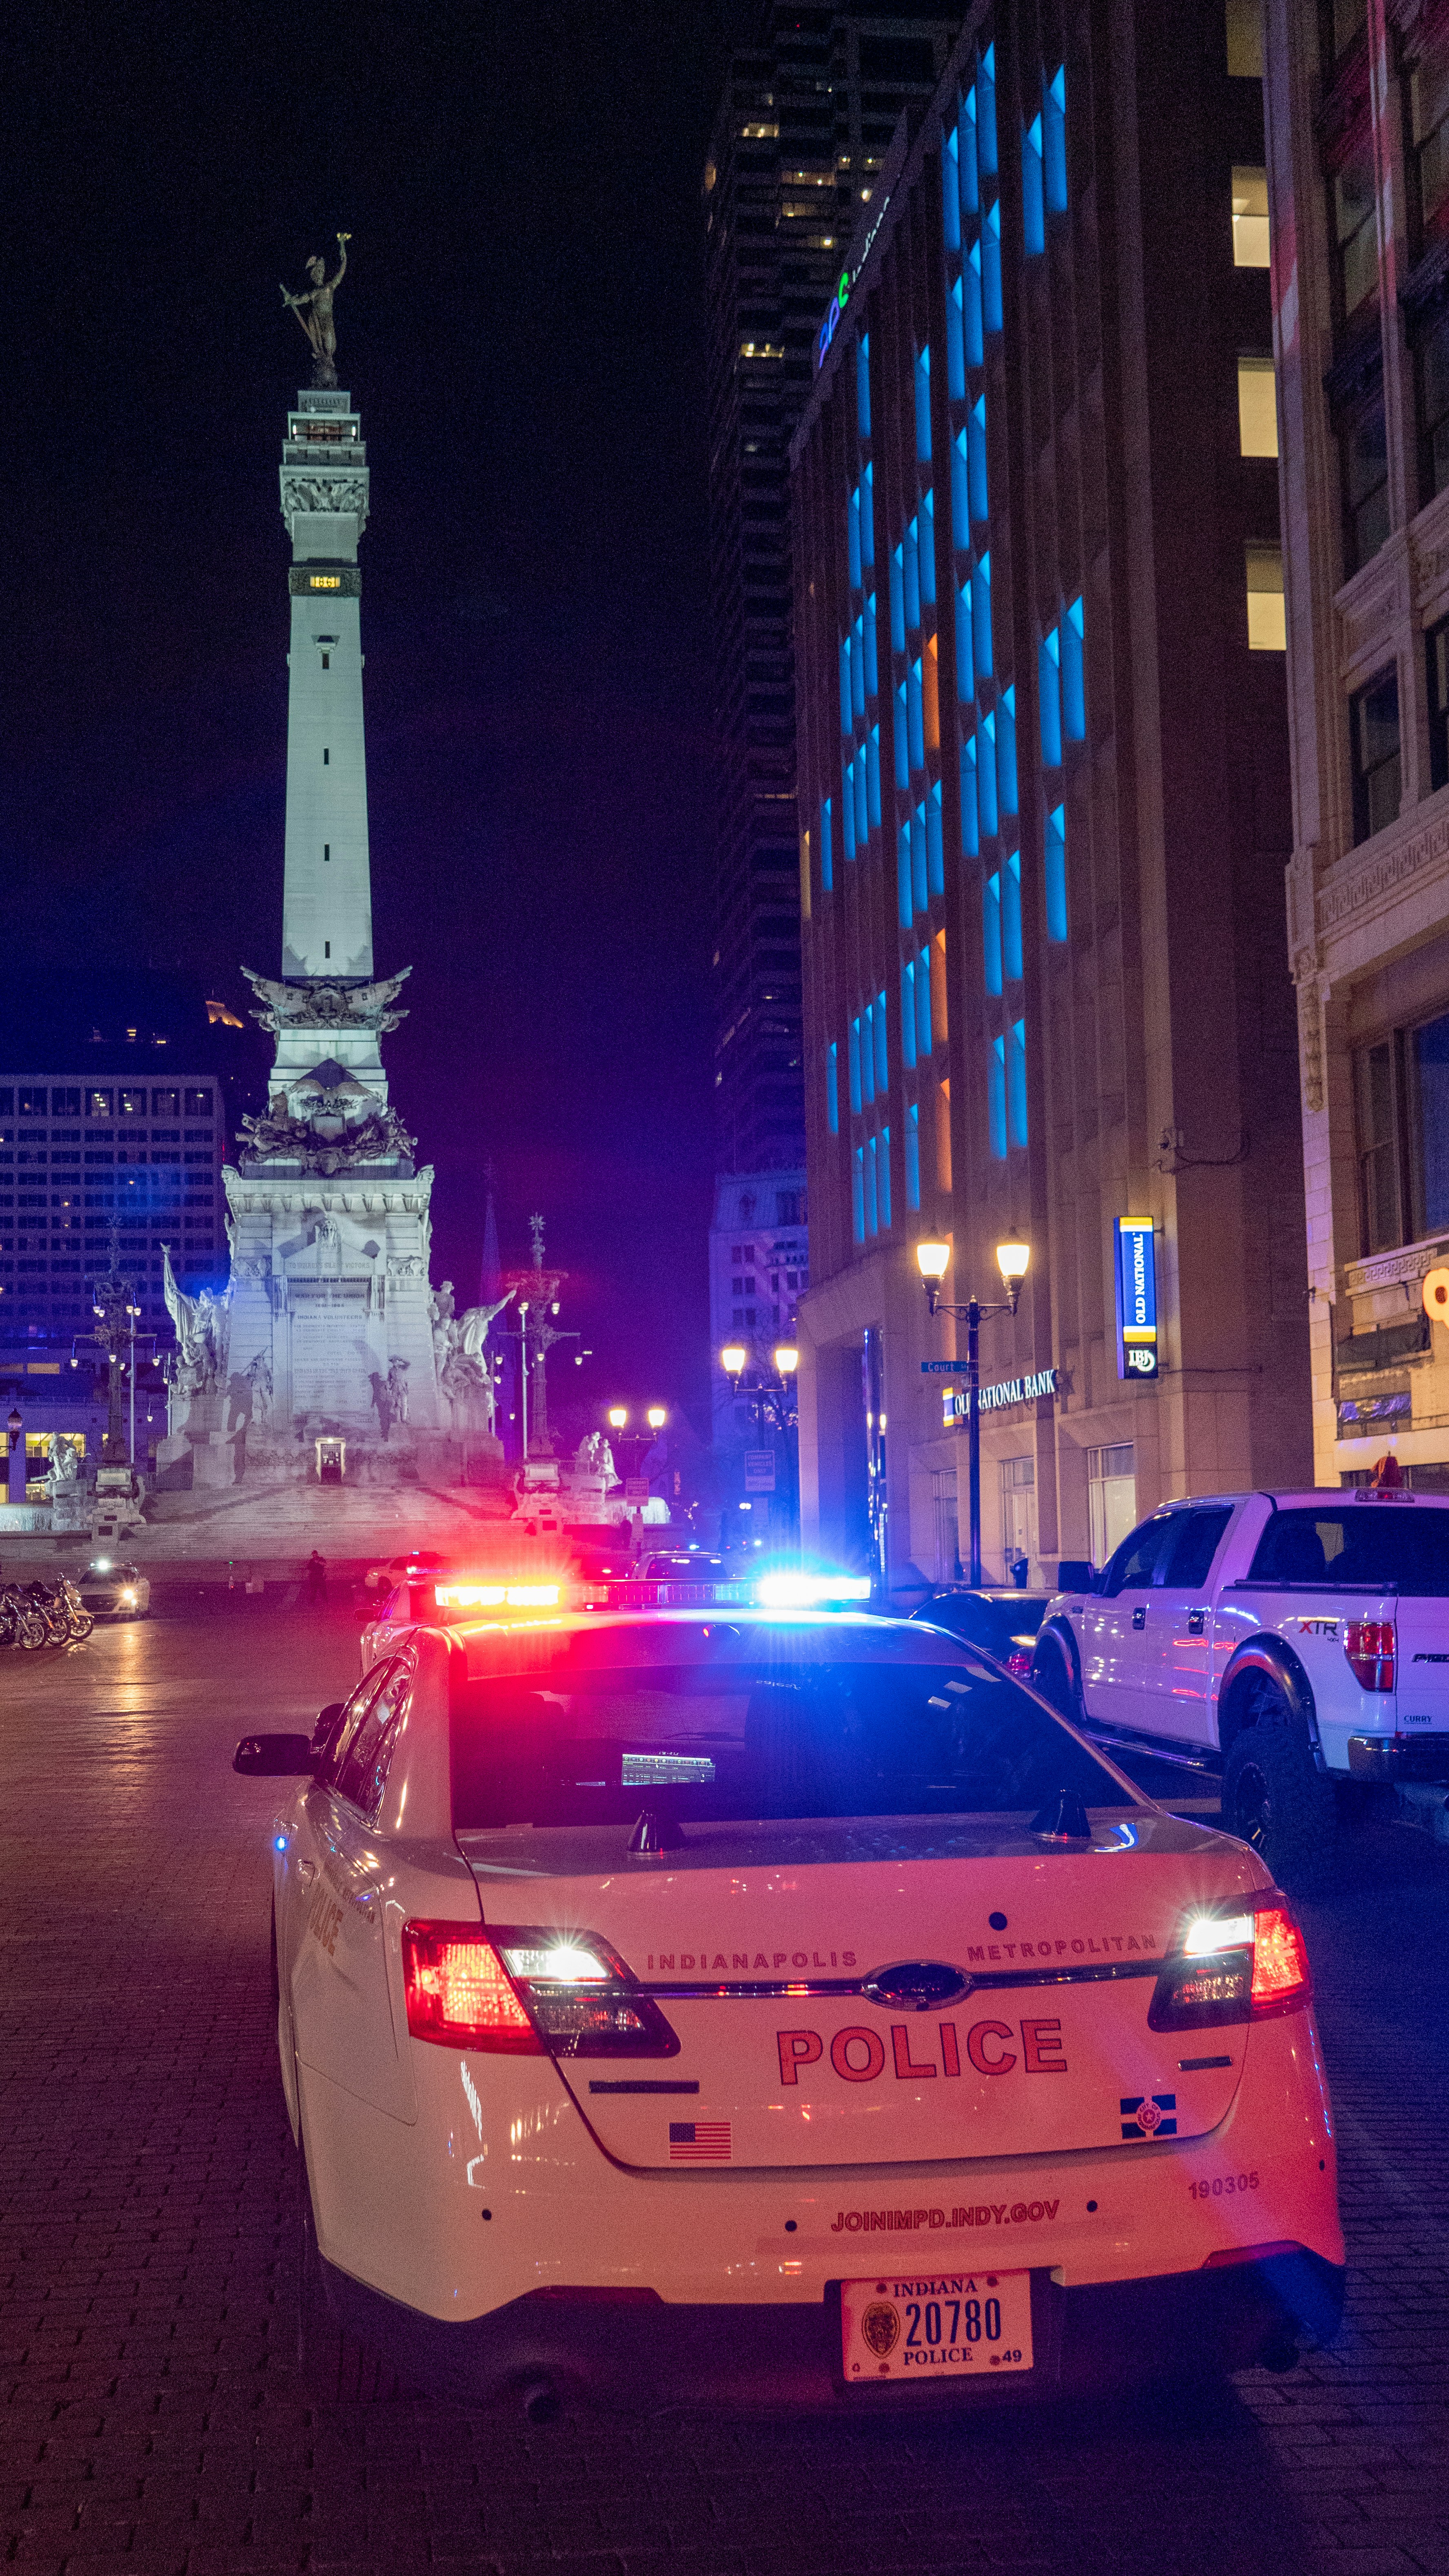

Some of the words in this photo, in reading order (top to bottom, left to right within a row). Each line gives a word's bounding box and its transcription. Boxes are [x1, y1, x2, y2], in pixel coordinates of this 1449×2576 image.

[1134, 1234, 1145, 1296] NATIONAL
[1136, 1297, 1146, 1324] OLD
[928, 1362, 954, 1372] Court
[1129, 1350, 1152, 1367] IBJ
[1024, 1369, 1055, 1398] BANK
[1299, 1620, 1338, 1636] XTR
[647, 1950, 857, 1970] INDIANAPOLIS
[967, 1934, 1156, 1961] METROPOLITAN
[777, 2019, 1068, 2086] POLICE
[1188, 2171, 1260, 2200] 190305
[831, 2200, 1060, 2232] JOINIMPD.INDY.GOV
[894, 2279, 978, 2297] INDIANA
[905, 2297, 1002, 2347] 20780
[904, 2348, 973, 2366] POLICE
[1002, 2349, 1022, 2363] 49
